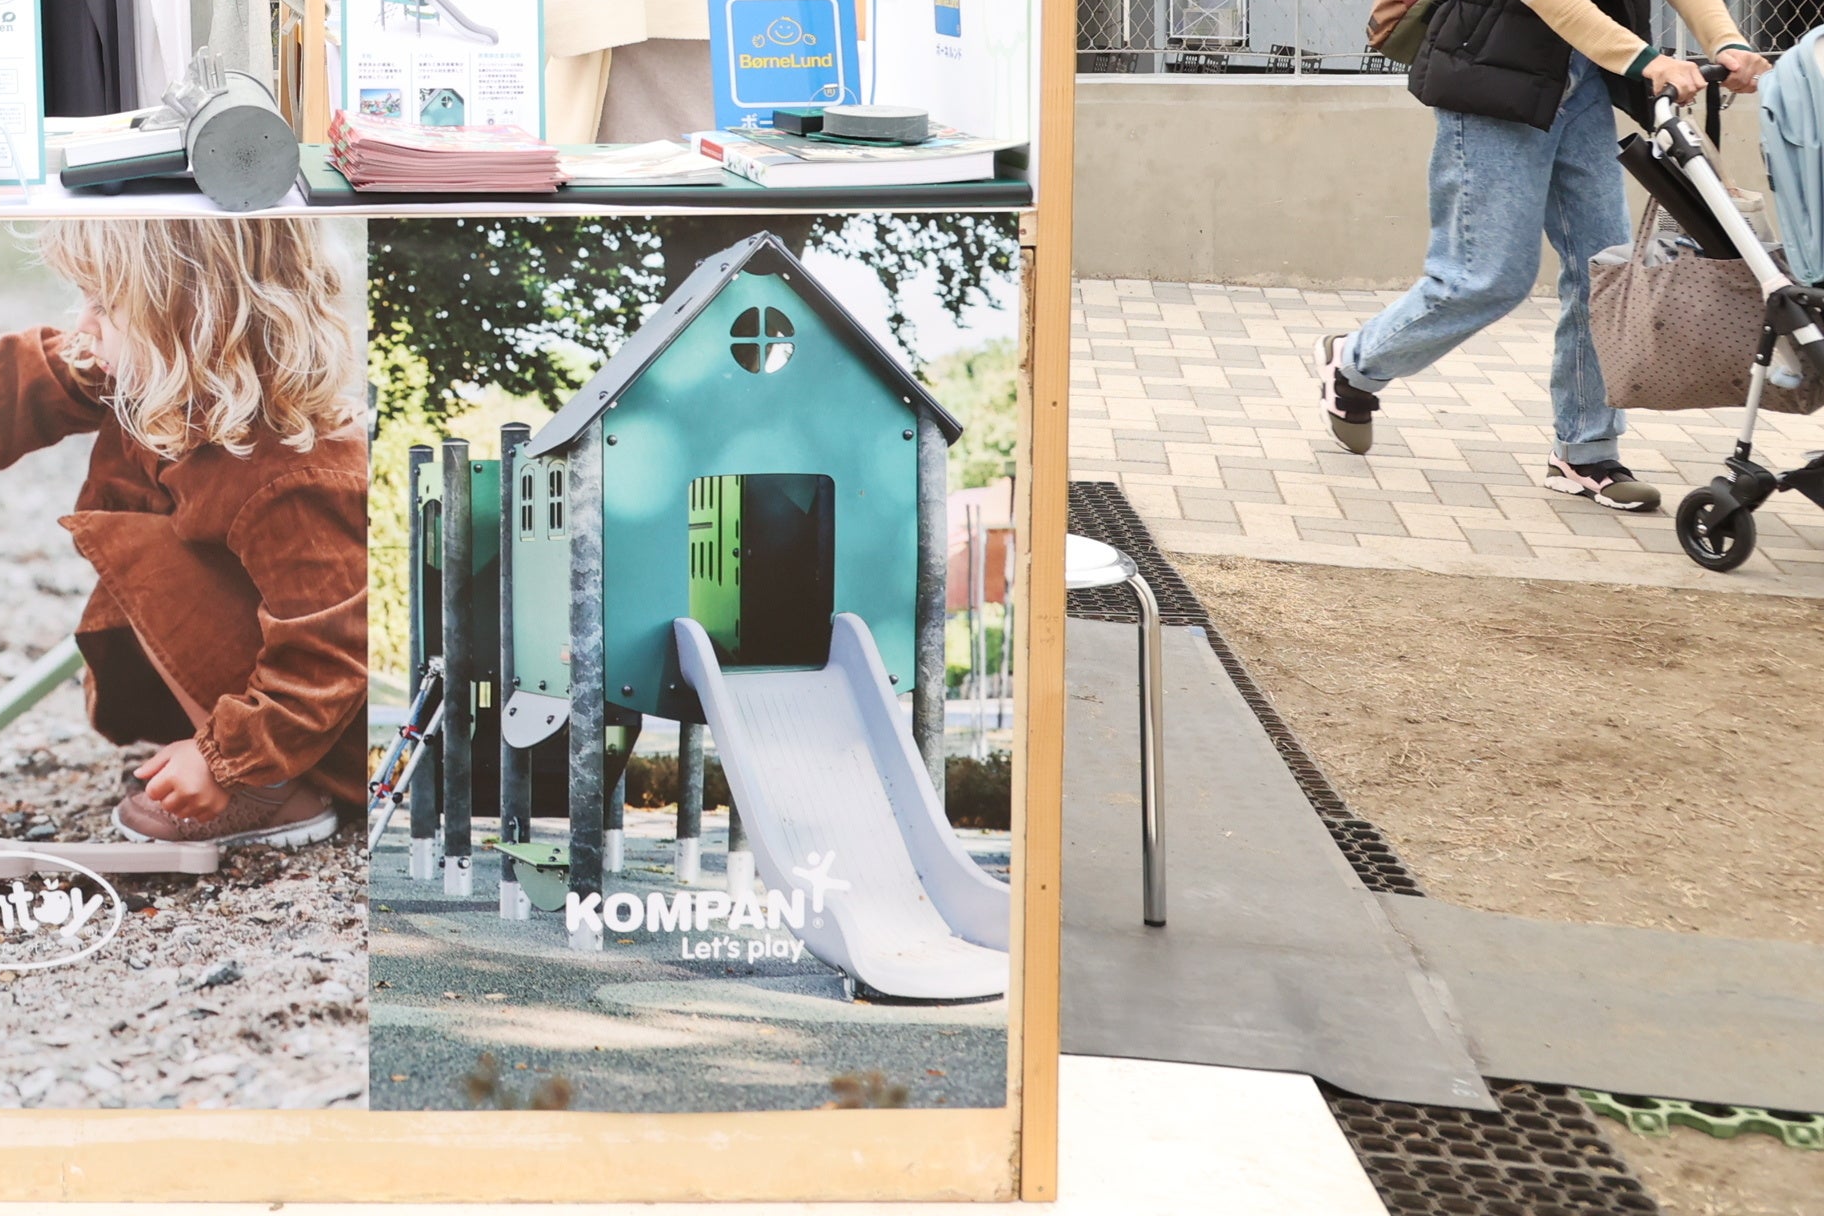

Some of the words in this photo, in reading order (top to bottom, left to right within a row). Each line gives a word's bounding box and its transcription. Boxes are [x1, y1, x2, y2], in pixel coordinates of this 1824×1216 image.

[739, 53, 832, 69] BørneLund
[565, 888, 805, 933] KOMPAN
[682, 935, 741, 960] Let's
[747, 935, 805, 964] play
